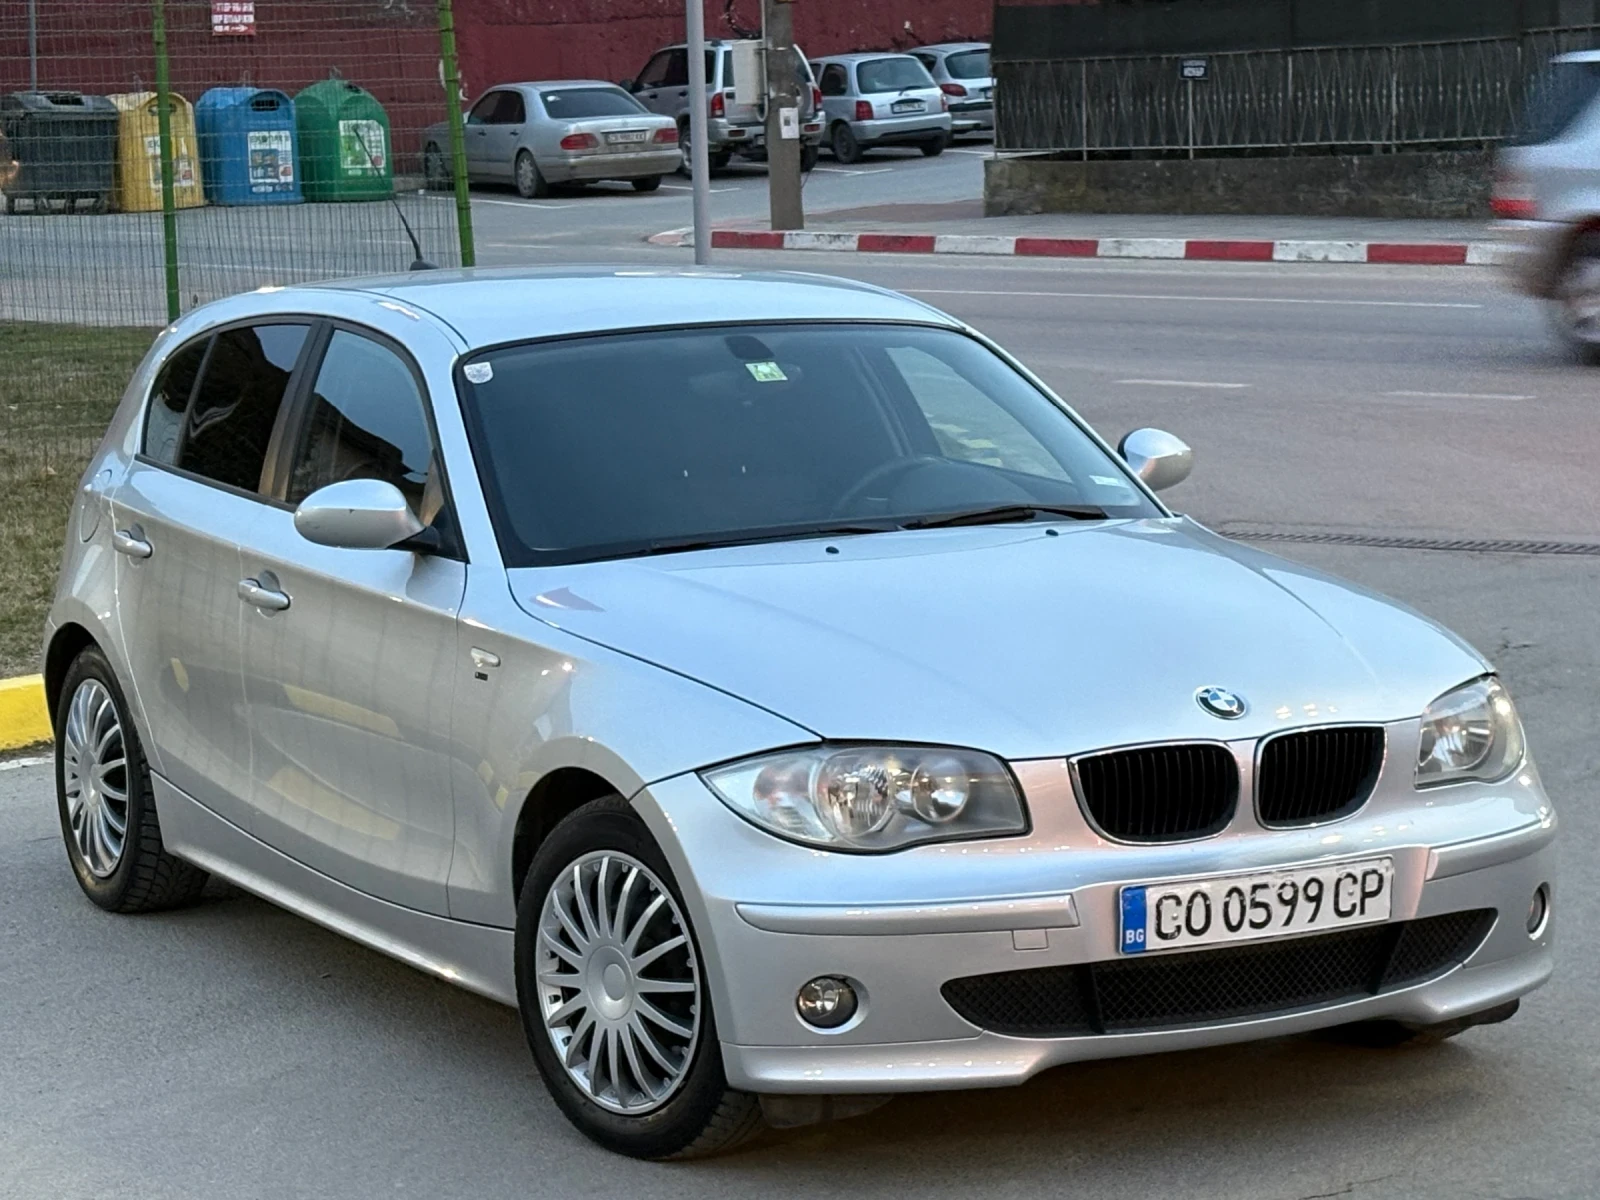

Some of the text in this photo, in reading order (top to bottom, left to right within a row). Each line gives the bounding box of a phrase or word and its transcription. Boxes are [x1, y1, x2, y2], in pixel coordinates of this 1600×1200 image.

[1223, 877, 1325, 933] 0599
[1333, 868, 1385, 919] CP
[1125, 928, 1145, 944] BG
